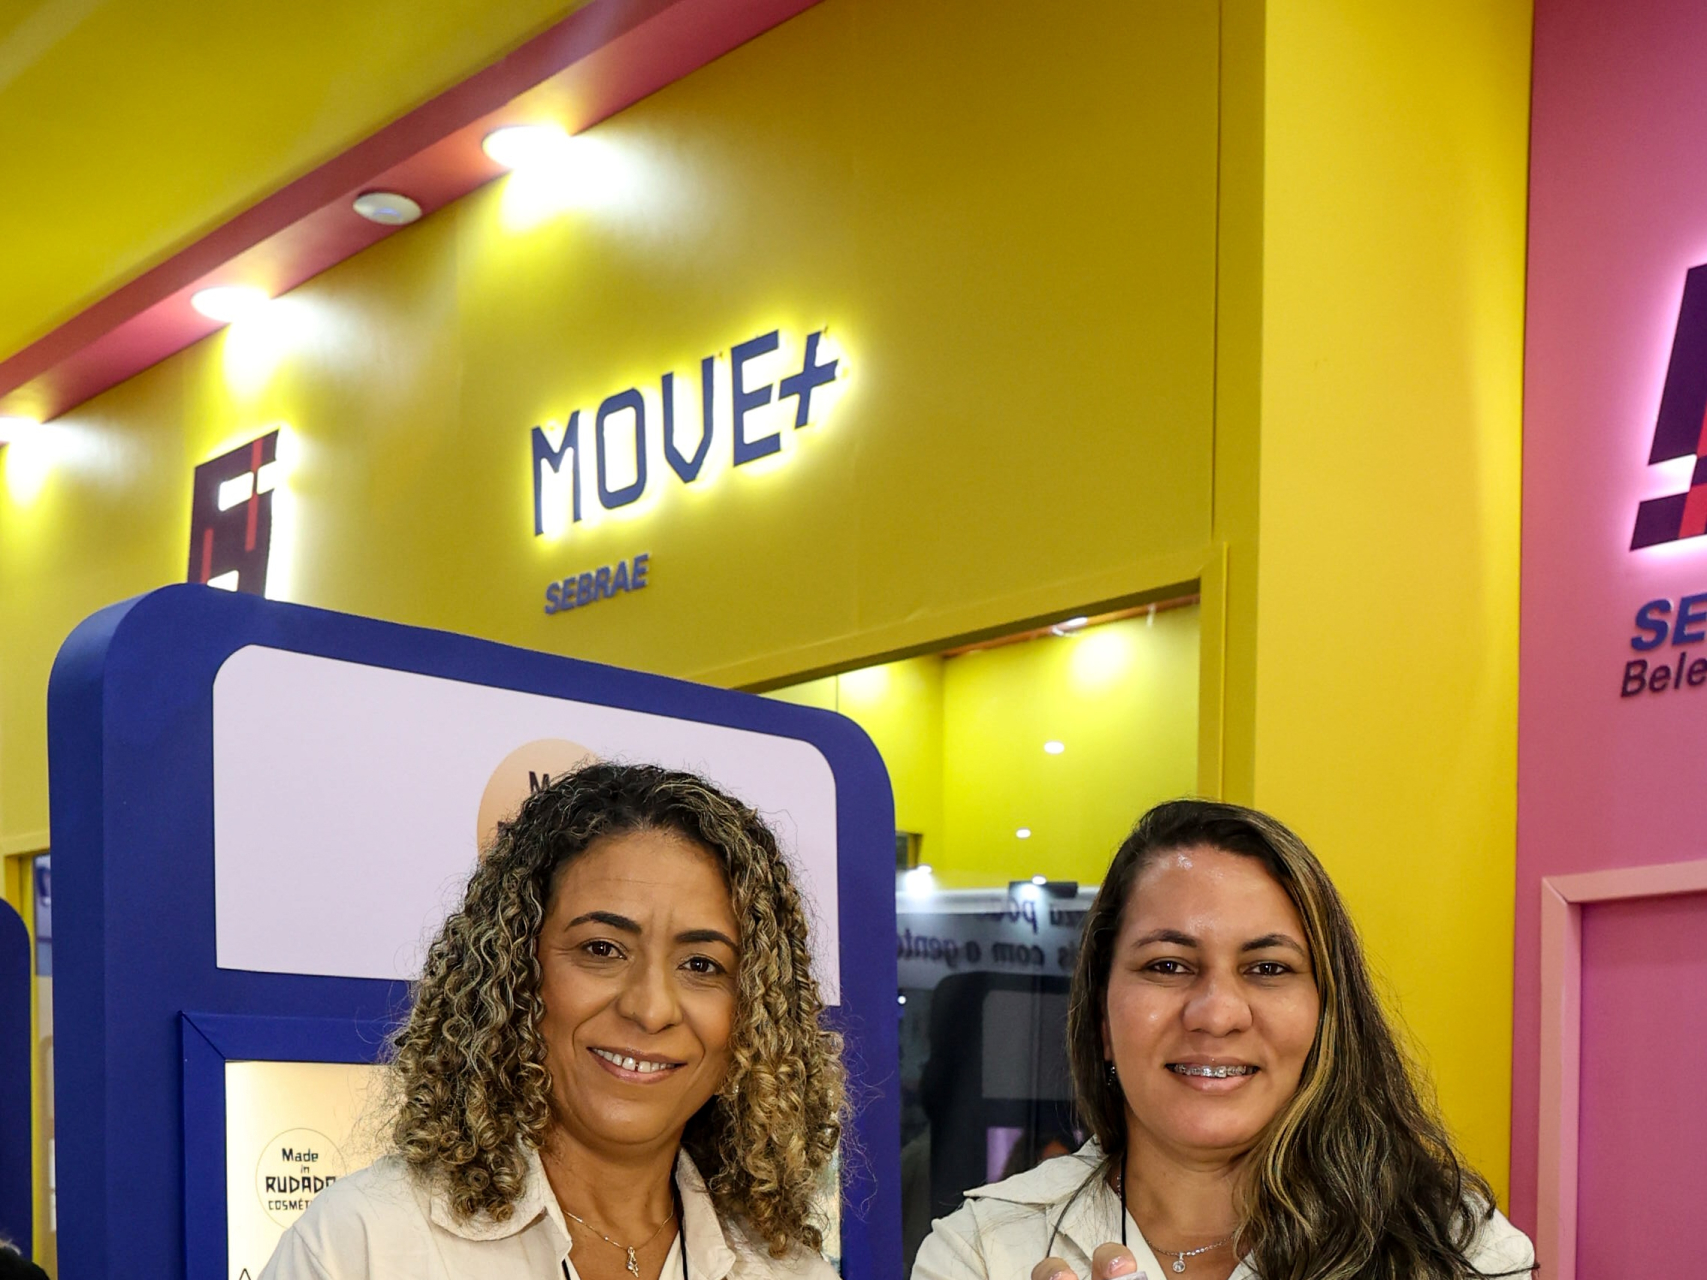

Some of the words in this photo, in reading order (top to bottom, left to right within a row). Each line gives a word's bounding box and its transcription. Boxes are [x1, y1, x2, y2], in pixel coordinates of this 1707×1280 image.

[531, 329, 839, 537] MOVE+
[545, 553, 649, 616] SEBRAE
[282, 1148, 319, 1162] Made
[300, 1164, 310, 1174] in
[268, 1198, 312, 1211] COSMÉT
